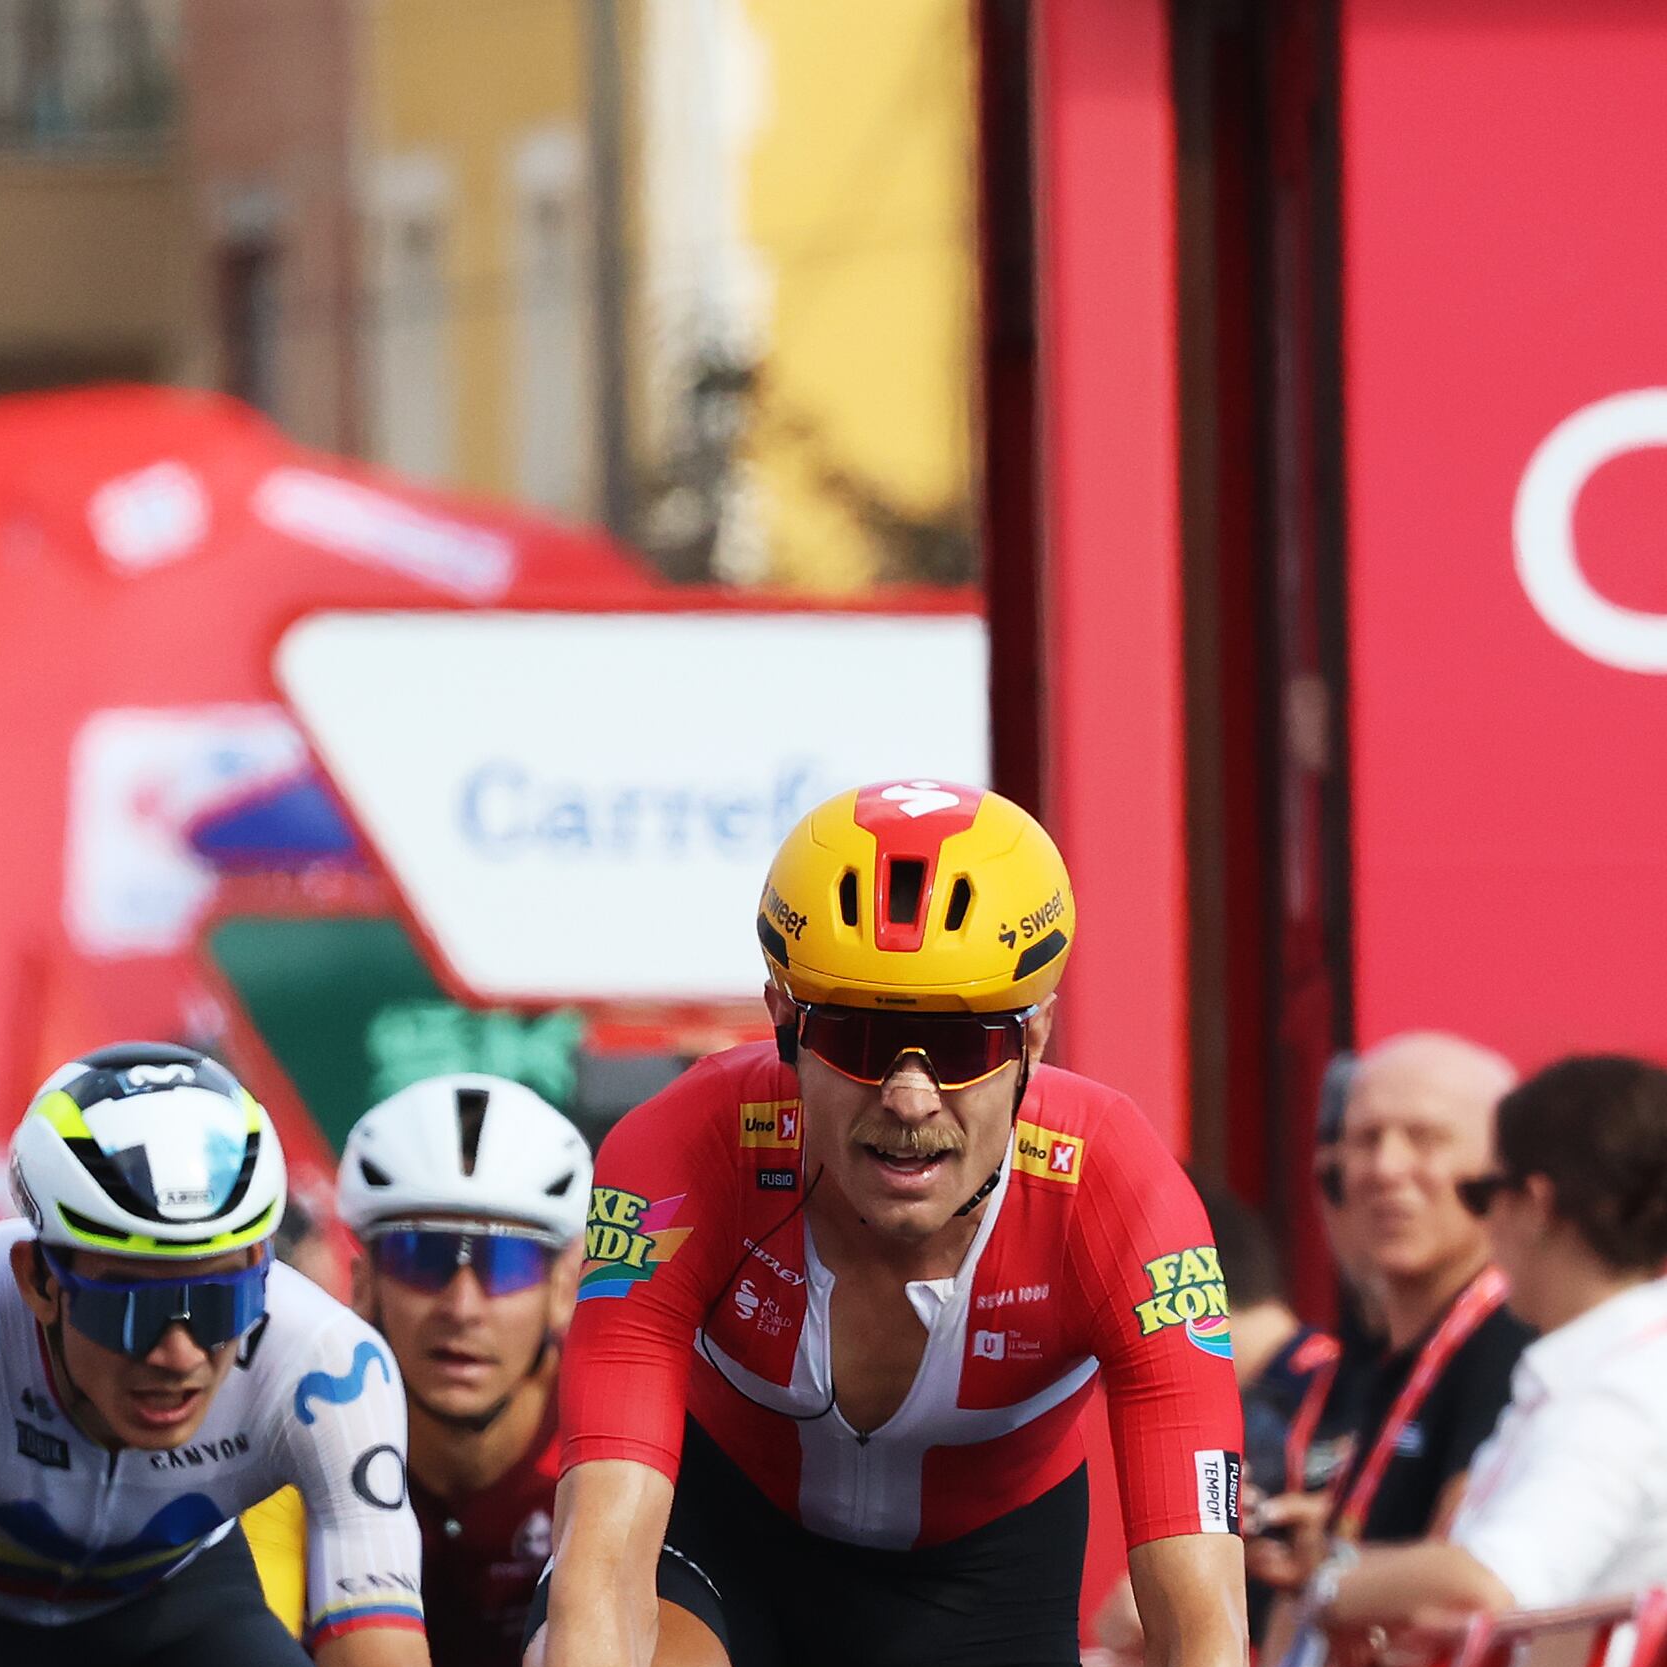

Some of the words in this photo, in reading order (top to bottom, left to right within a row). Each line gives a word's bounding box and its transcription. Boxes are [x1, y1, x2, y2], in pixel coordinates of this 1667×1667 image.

[1020, 880, 1067, 939] sweet
[745, 1117, 775, 1133] Uno
[780, 1109, 797, 1140] X
[1018, 1139, 1047, 1160] Uno
[1052, 1144, 1075, 1172] X
[743, 1237, 805, 1287] RIDLEY
[149, 1432, 250, 1471] CANYON
[1228, 1461, 1240, 1519] FUSION
